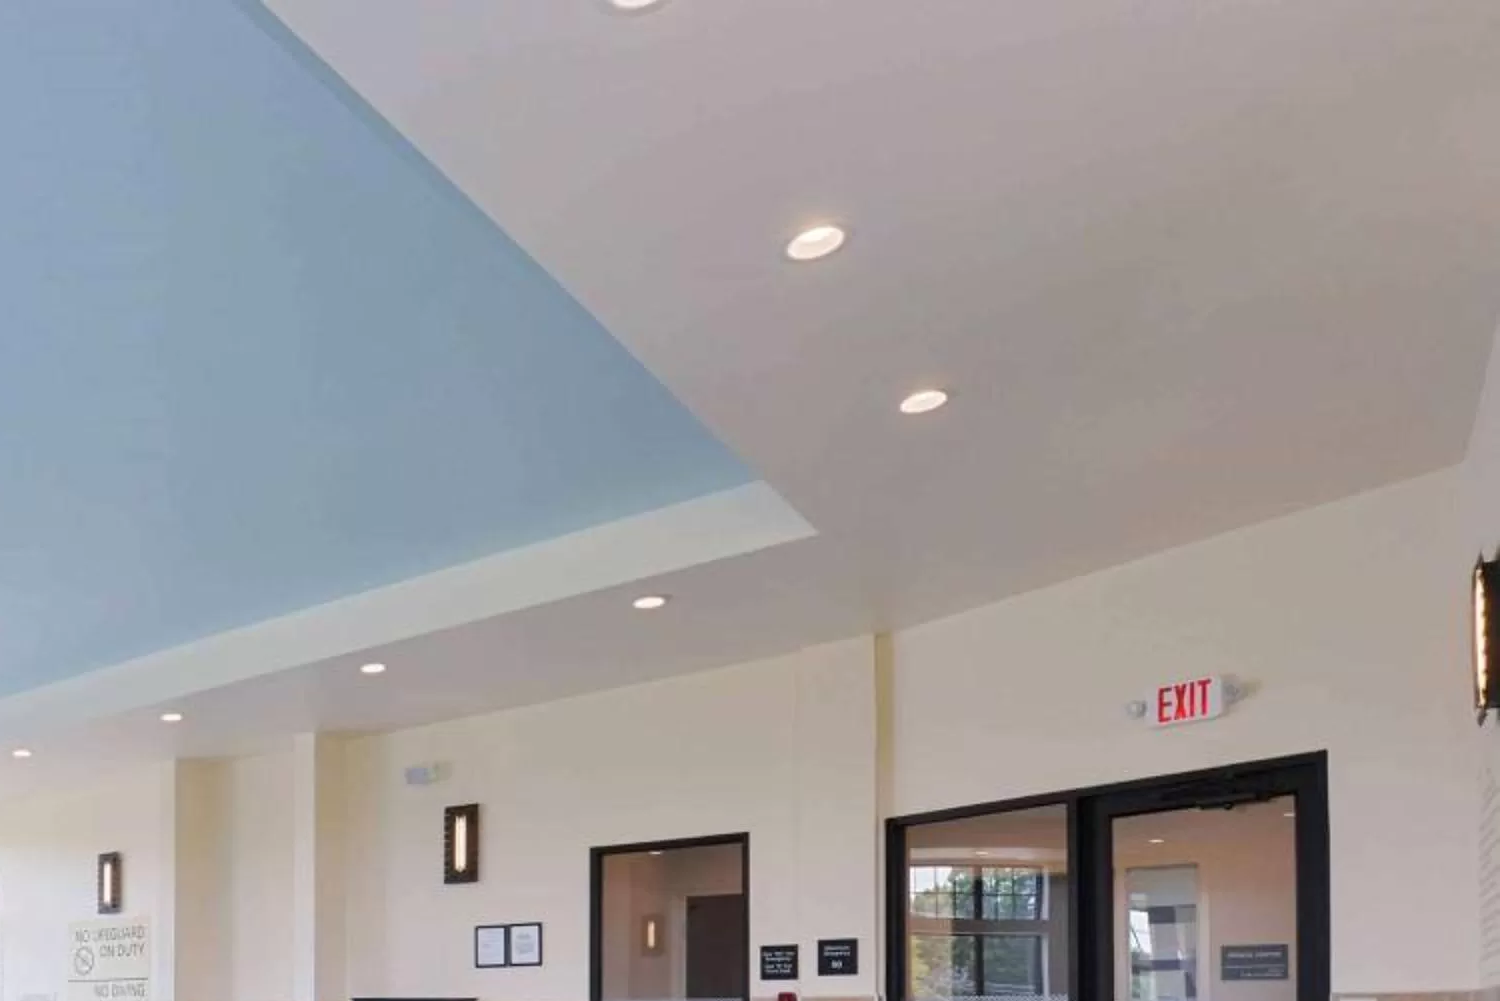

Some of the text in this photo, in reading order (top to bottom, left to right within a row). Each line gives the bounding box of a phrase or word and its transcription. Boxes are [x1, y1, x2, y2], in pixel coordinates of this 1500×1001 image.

[1158, 678, 1212, 723] EXIT
[75, 929, 90, 943] NO
[99, 942, 145, 957] ON DUTY
[94, 983, 109, 997] NO
